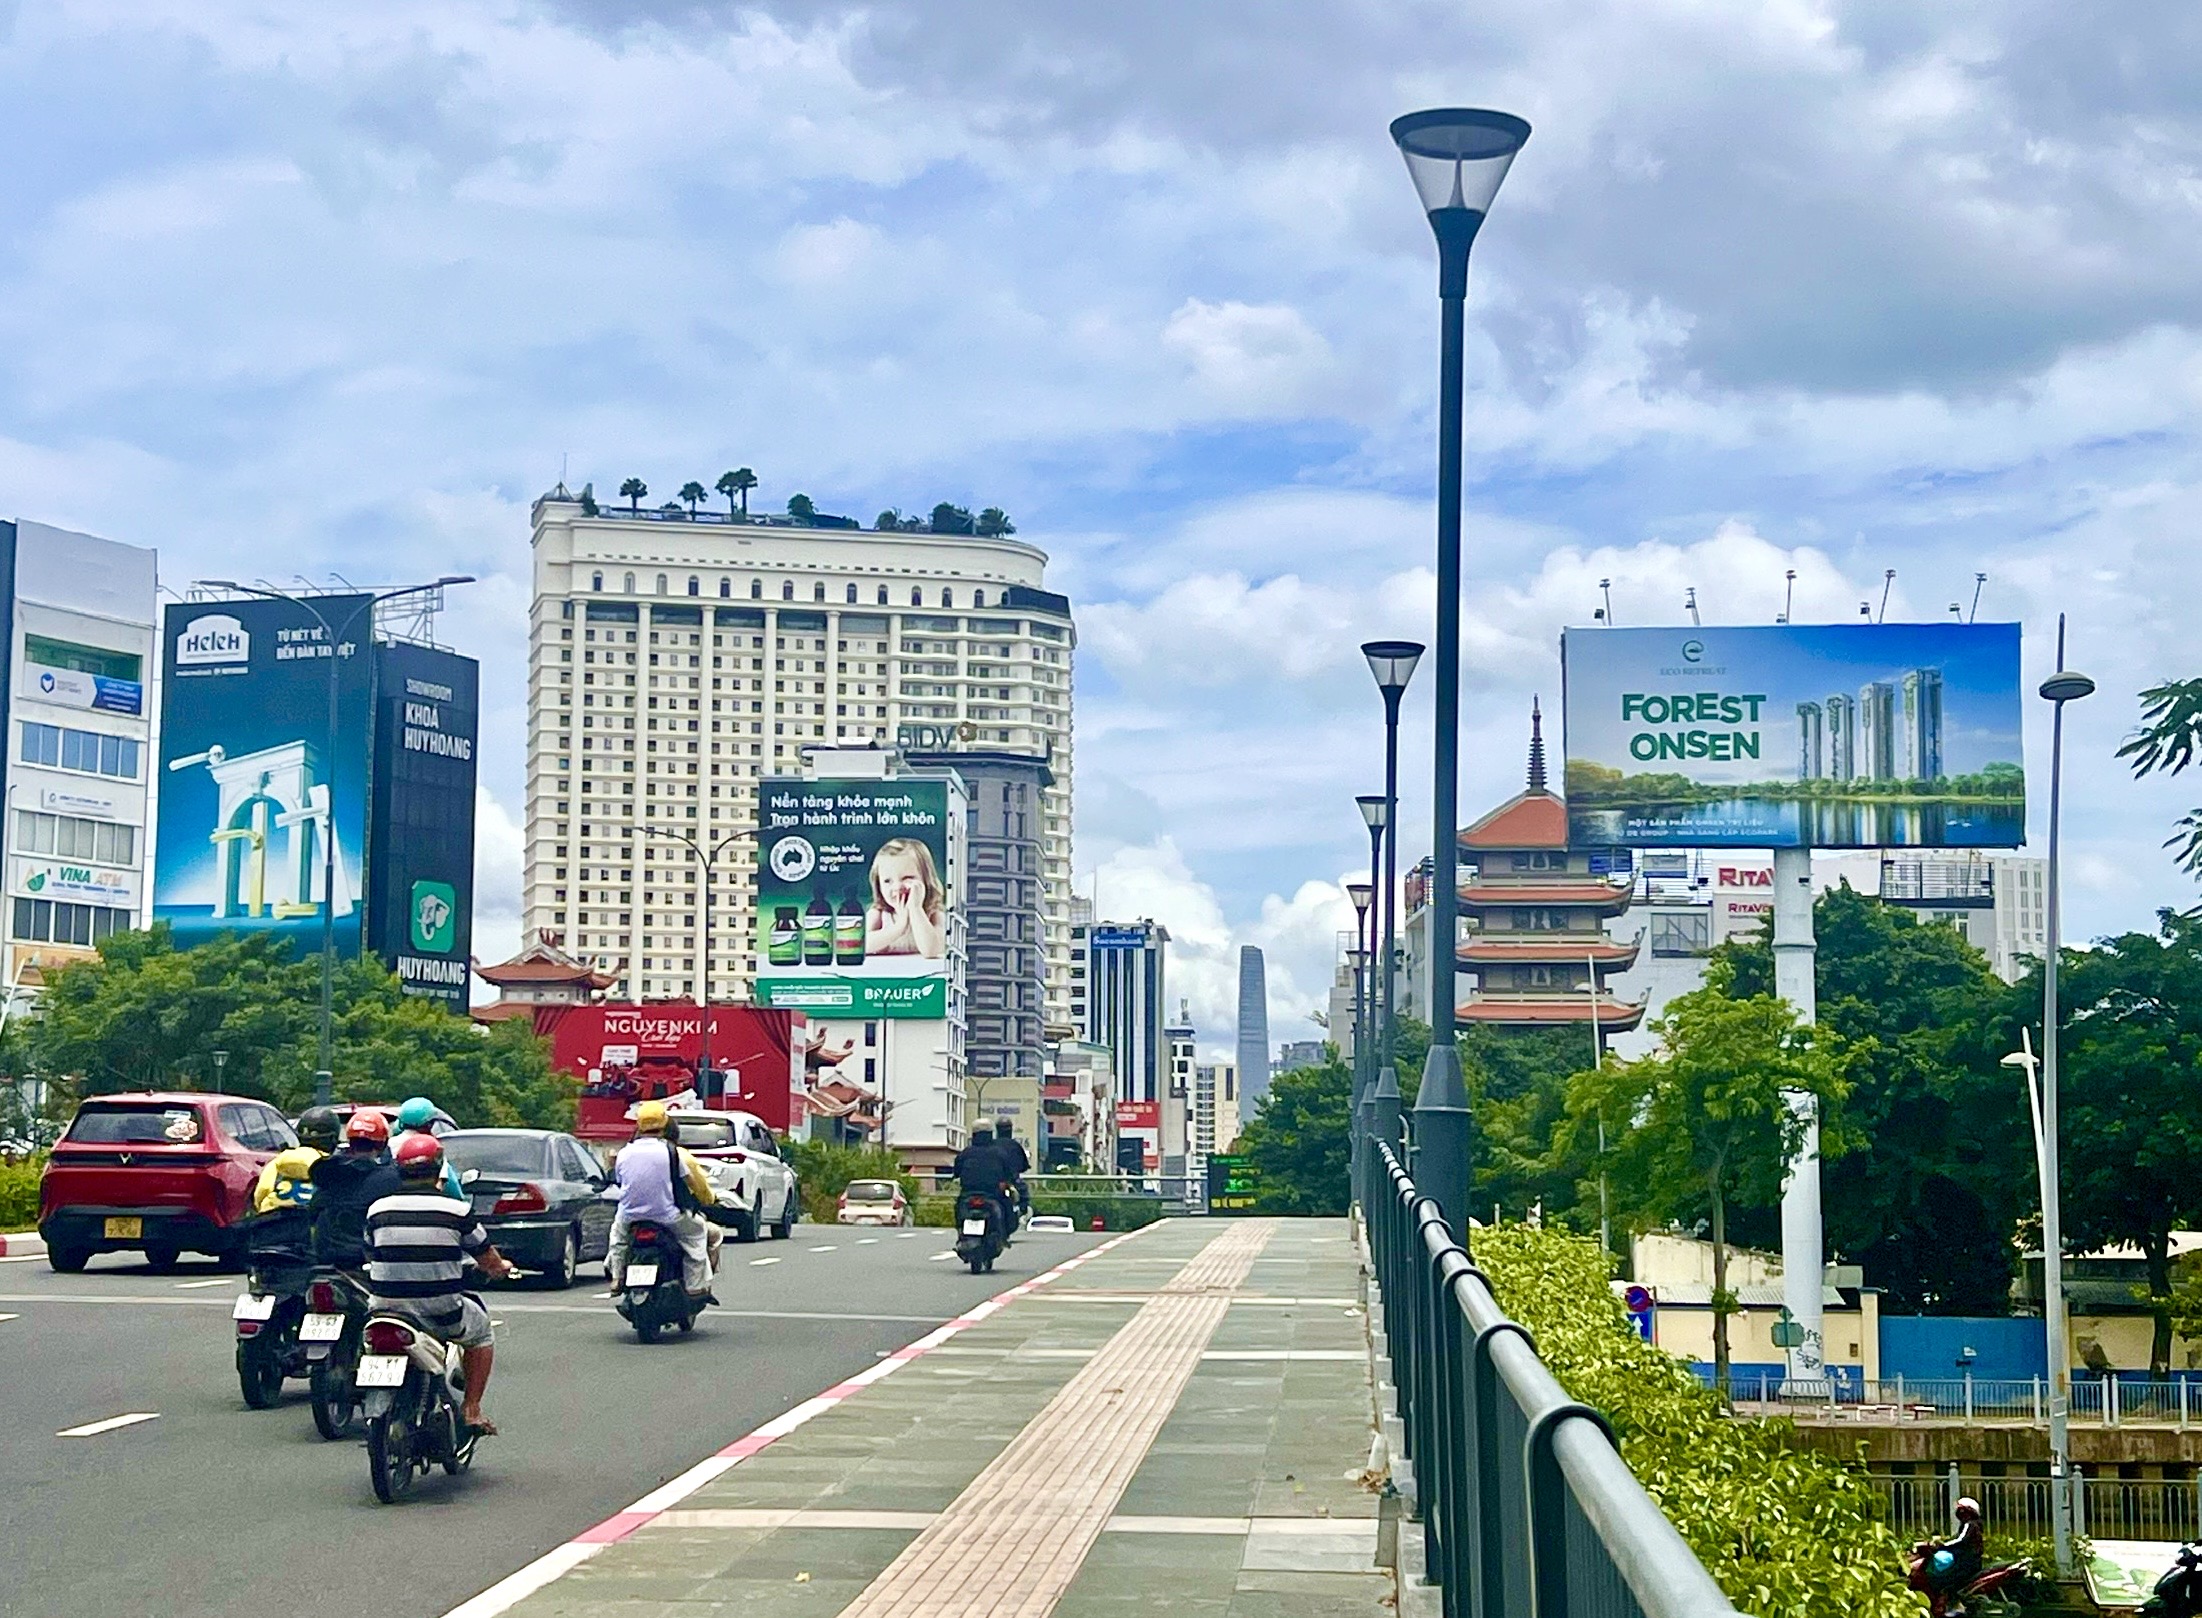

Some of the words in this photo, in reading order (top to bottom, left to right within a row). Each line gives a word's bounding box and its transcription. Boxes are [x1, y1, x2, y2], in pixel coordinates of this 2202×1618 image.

[1661, 667, 1681, 676] ECO
[1622, 692, 1767, 724] FOREST
[405, 727, 471, 760] HUYHOANG
[898, 725, 957, 748] BIDV
[1630, 730, 1760, 761] ONSEN
[771, 791, 798, 808] Nền
[802, 795, 833, 811] tảng
[874, 795, 913, 811] mạnh
[770, 813, 798, 828] Trọn
[803, 812, 837, 825] hành
[841, 812, 872, 825] trình
[877, 812, 899, 825] lớn
[902, 812, 936, 825] khôn
[60, 866, 91, 883] VINA
[398, 956, 466, 985] HUYHOANG
[865, 988, 922, 1000] BRAUER
[605, 1019, 718, 1035] NGUYENKIM
